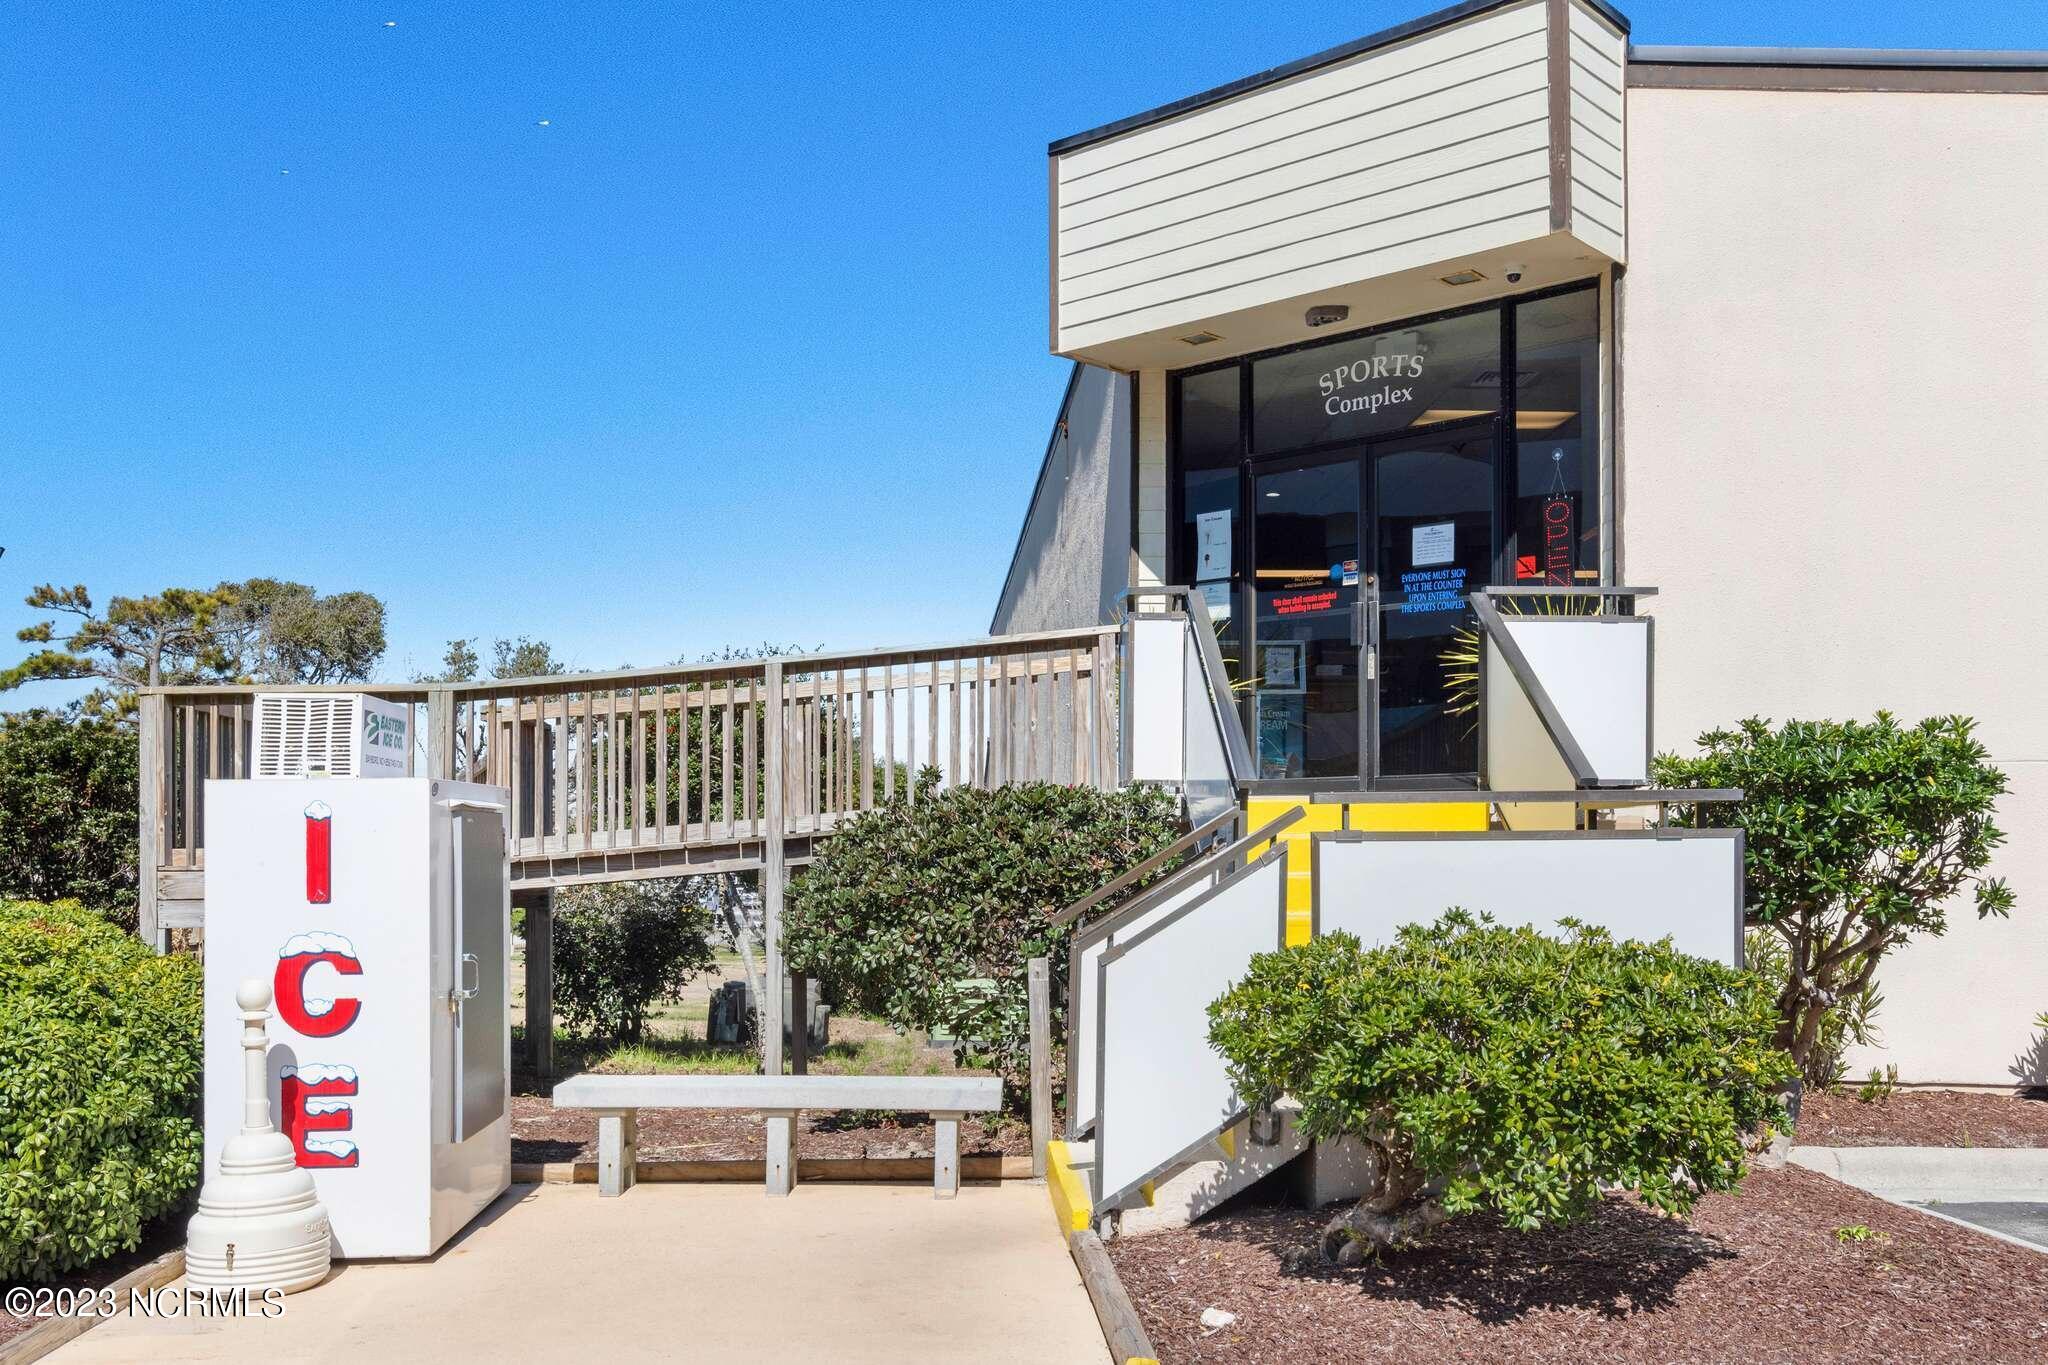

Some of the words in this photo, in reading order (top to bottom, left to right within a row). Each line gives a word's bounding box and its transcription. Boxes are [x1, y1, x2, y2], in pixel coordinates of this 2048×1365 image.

[1319, 354, 1424, 396] SPORTS
[1325, 384, 1413, 416] Complex
[1546, 502, 1570, 587] OPEN
[1401, 572, 1432, 583] EVERYONE
[1432, 569, 1450, 580] MUST
[1450, 568, 1467, 578] SIGN
[1404, 583, 1411, 593] IN
[1412, 583, 1420, 592] AT
[1420, 582, 1433, 592] THE
[1433, 579, 1464, 591] COUNTER
[1401, 603, 1413, 614] THE
[1412, 601, 1436, 613] SPORTS
[1436, 599, 1466, 611] COMPLEX
[1408, 592, 1427, 602] UPON
[1428, 589, 1458, 601] ENTERING
[274, 799, 364, 1169] ICE
